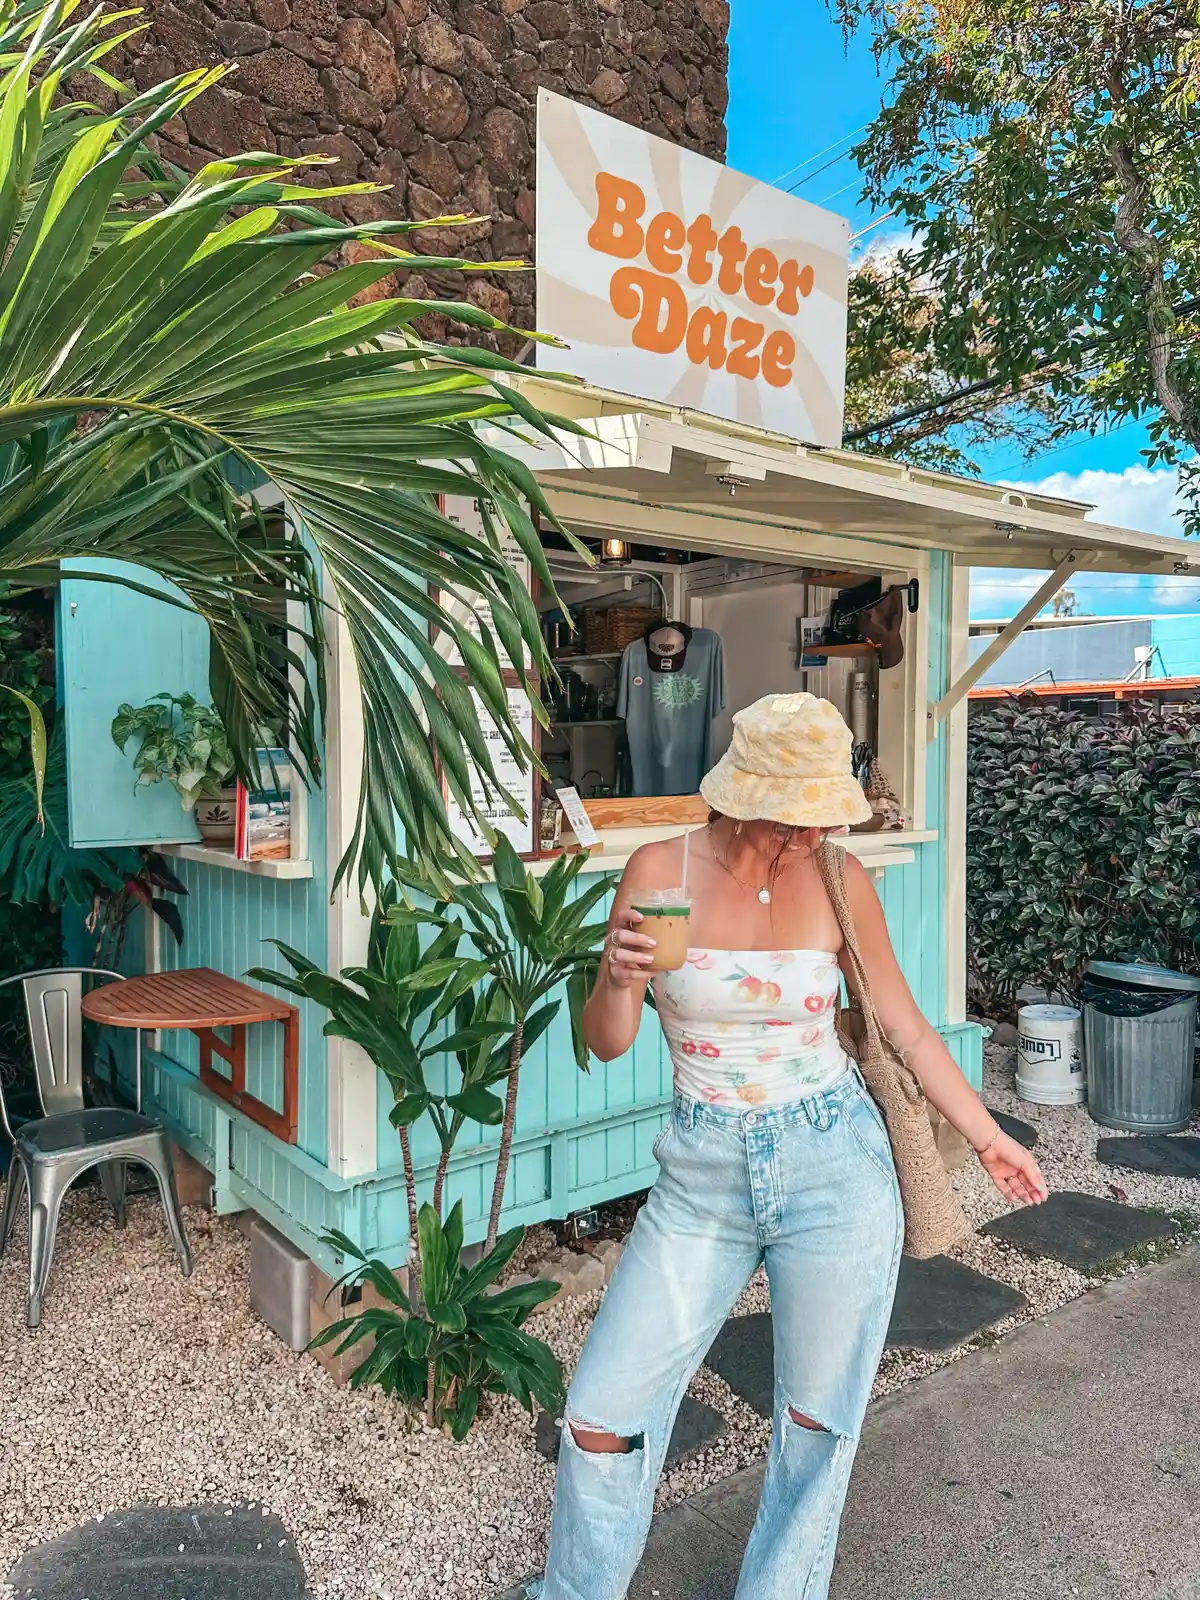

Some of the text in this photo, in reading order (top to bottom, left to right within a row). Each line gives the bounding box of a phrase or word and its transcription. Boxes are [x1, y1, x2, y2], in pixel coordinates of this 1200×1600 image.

[587, 171, 814, 316] Better
[609, 266, 796, 388] Daze
[1019, 1037, 1054, 1056] LOWE
